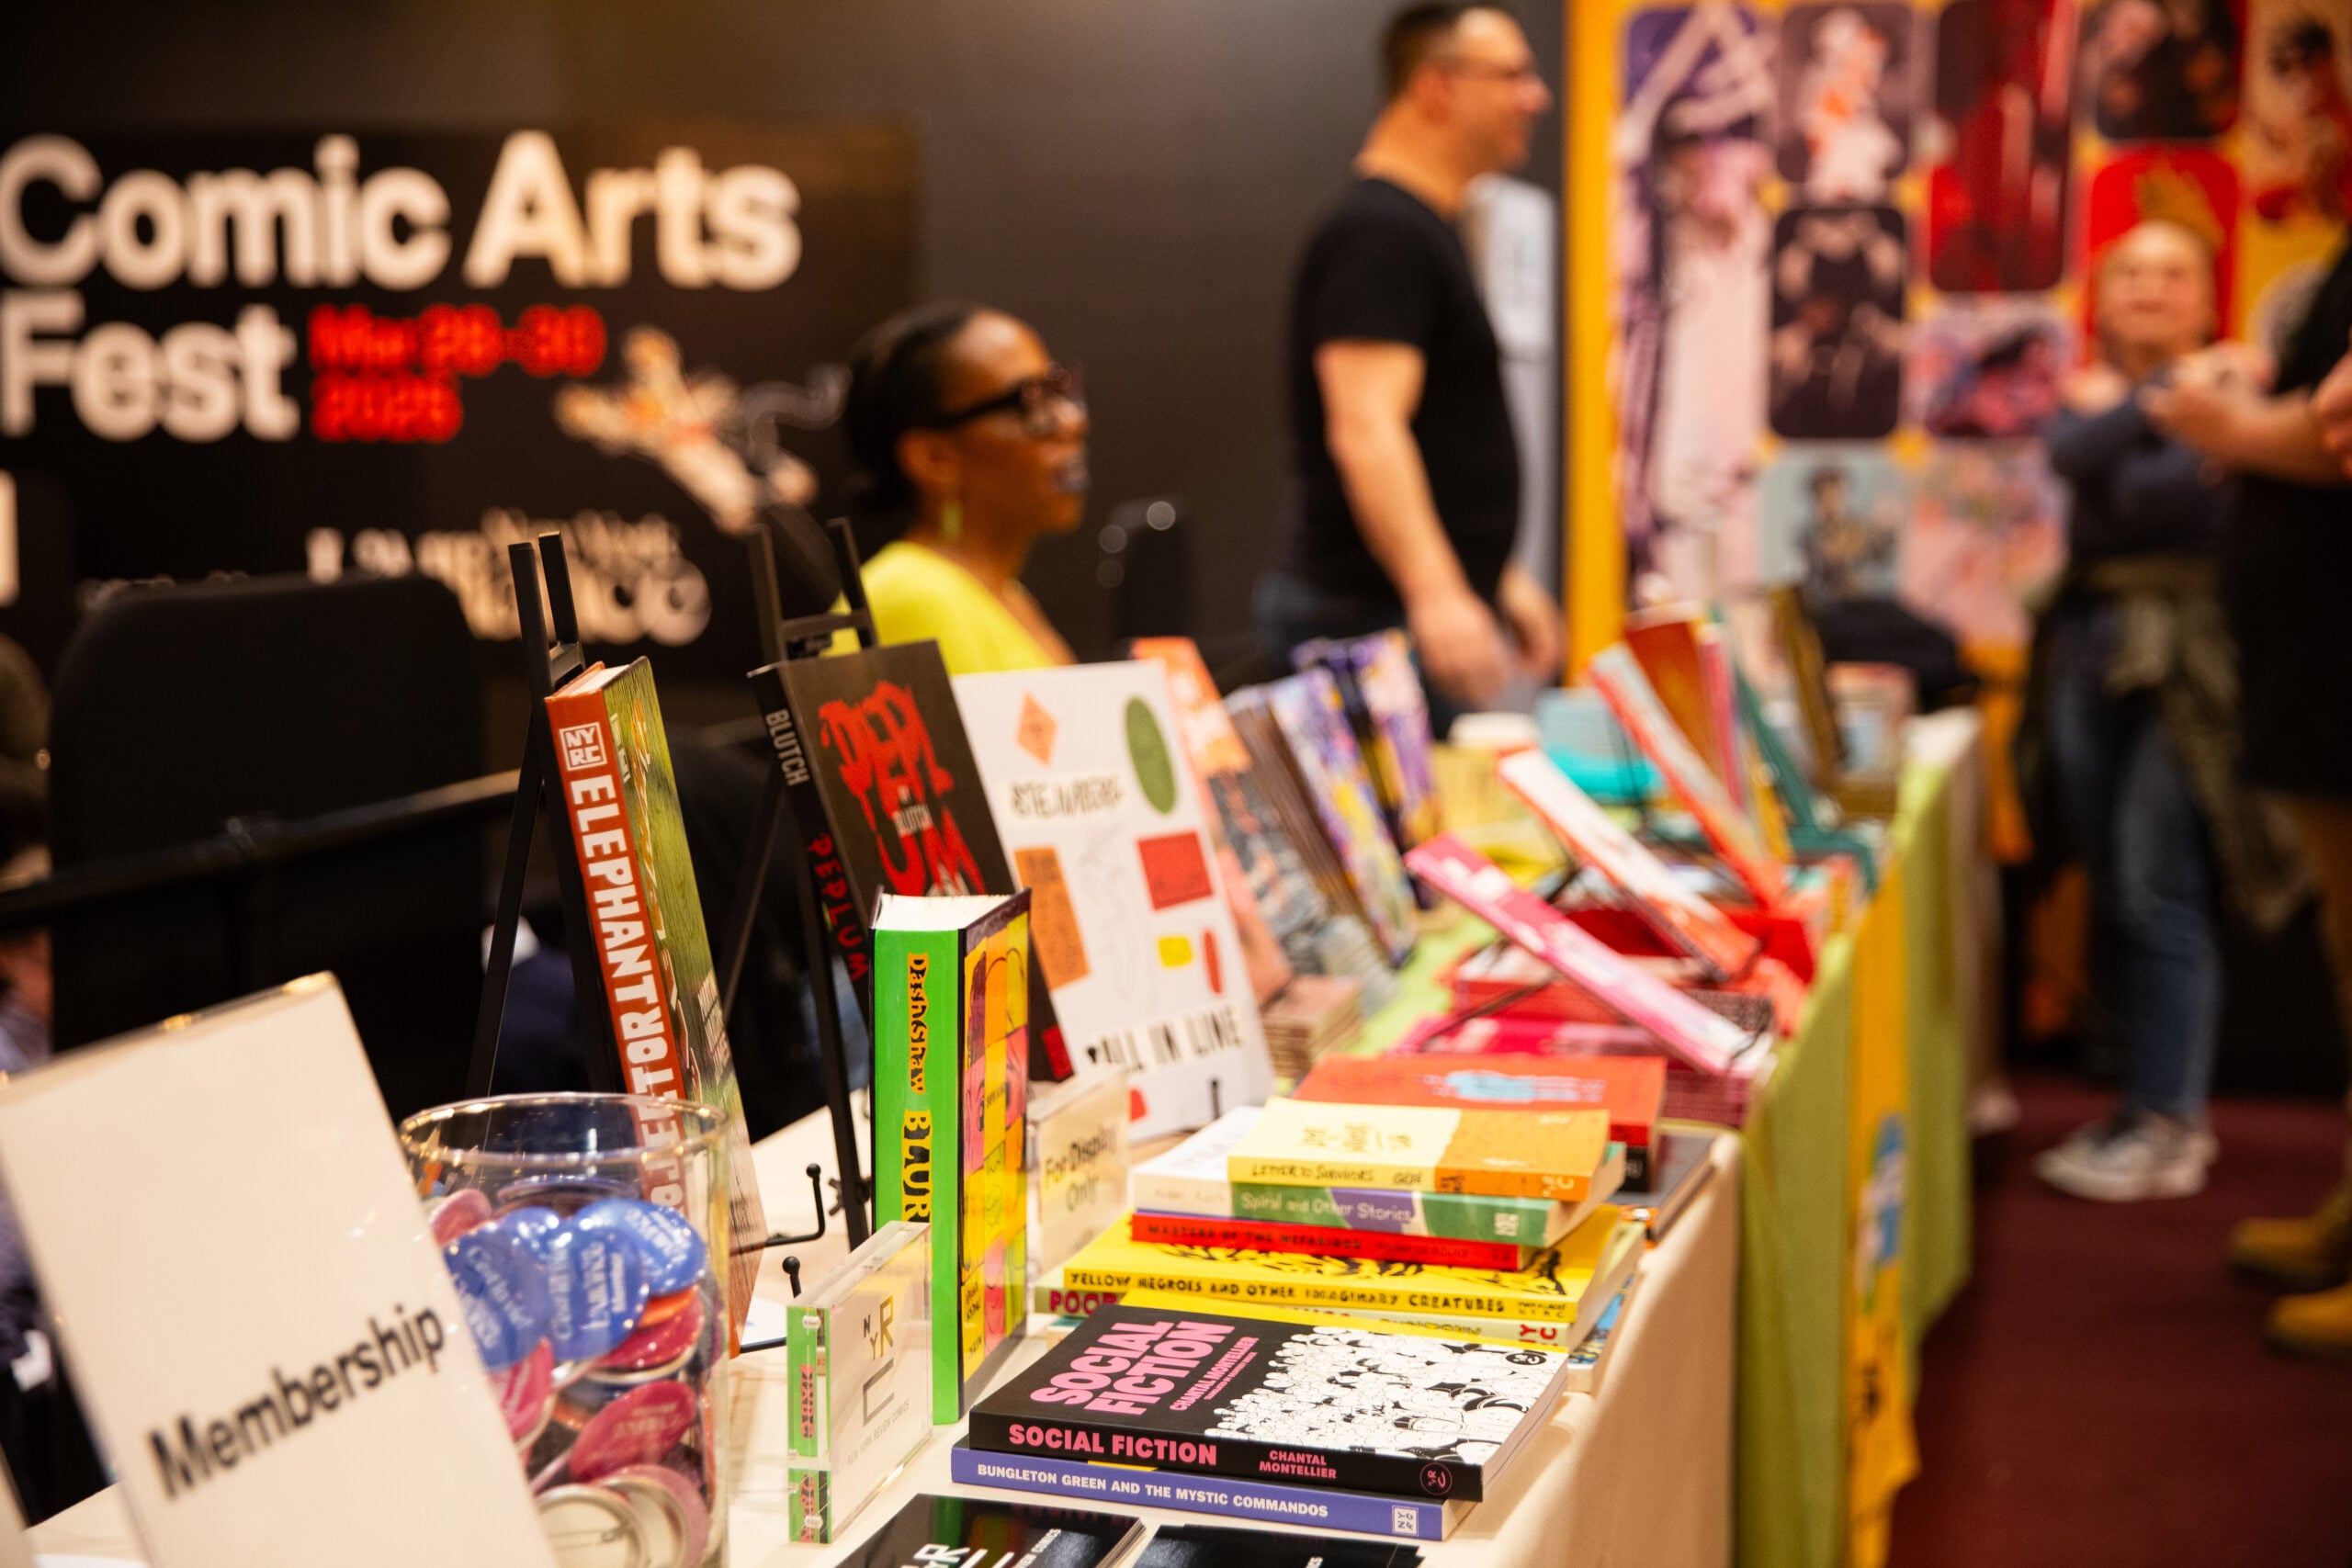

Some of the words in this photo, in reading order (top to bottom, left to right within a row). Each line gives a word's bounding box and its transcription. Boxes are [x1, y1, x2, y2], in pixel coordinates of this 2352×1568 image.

[0, 134, 452, 289] Comic
[461, 130, 802, 289] Arts
[0, 289, 300, 442] Fest
[765, 708, 810, 786] BLUTCH
[807, 833, 869, 982] PEPLUM
[1240, 1193, 1283, 1213] Spiral
[1286, 1199, 1310, 1214] and
[1311, 1196, 1352, 1217] Other
[1356, 1202, 1414, 1224] Stories
[1070, 1271, 1132, 1288] YELLOW
[1137, 1275, 1203, 1292] NEGROES
[1209, 1281, 1240, 1297] AND
[1246, 1283, 1296, 1299] OTHER
[1408, 1294, 1506, 1313] CREATURES
[1030, 1320, 1175, 1405] SOCIAL
[1083, 1320, 1237, 1416] FICTION
[1168, 1378, 1216, 1411] CHANTAL
[147, 1303, 445, 1502] Membership
[1009, 1424, 1104, 1454] SOCIAL
[1111, 1435, 1217, 1466] FICTION
[1260, 1461, 1338, 1480] MONTELLIER
[1269, 1449, 1328, 1466] CHANTAL
[978, 1463, 1057, 1484] BUNGLETON
[1061, 1473, 1107, 1492] GREEN
[1111, 1480, 1141, 1495] AND
[1145, 1483, 1171, 1499] THE
[1175, 1487, 1229, 1506] MYSTIC
[1232, 1494, 1329, 1518] COMMANDOS
